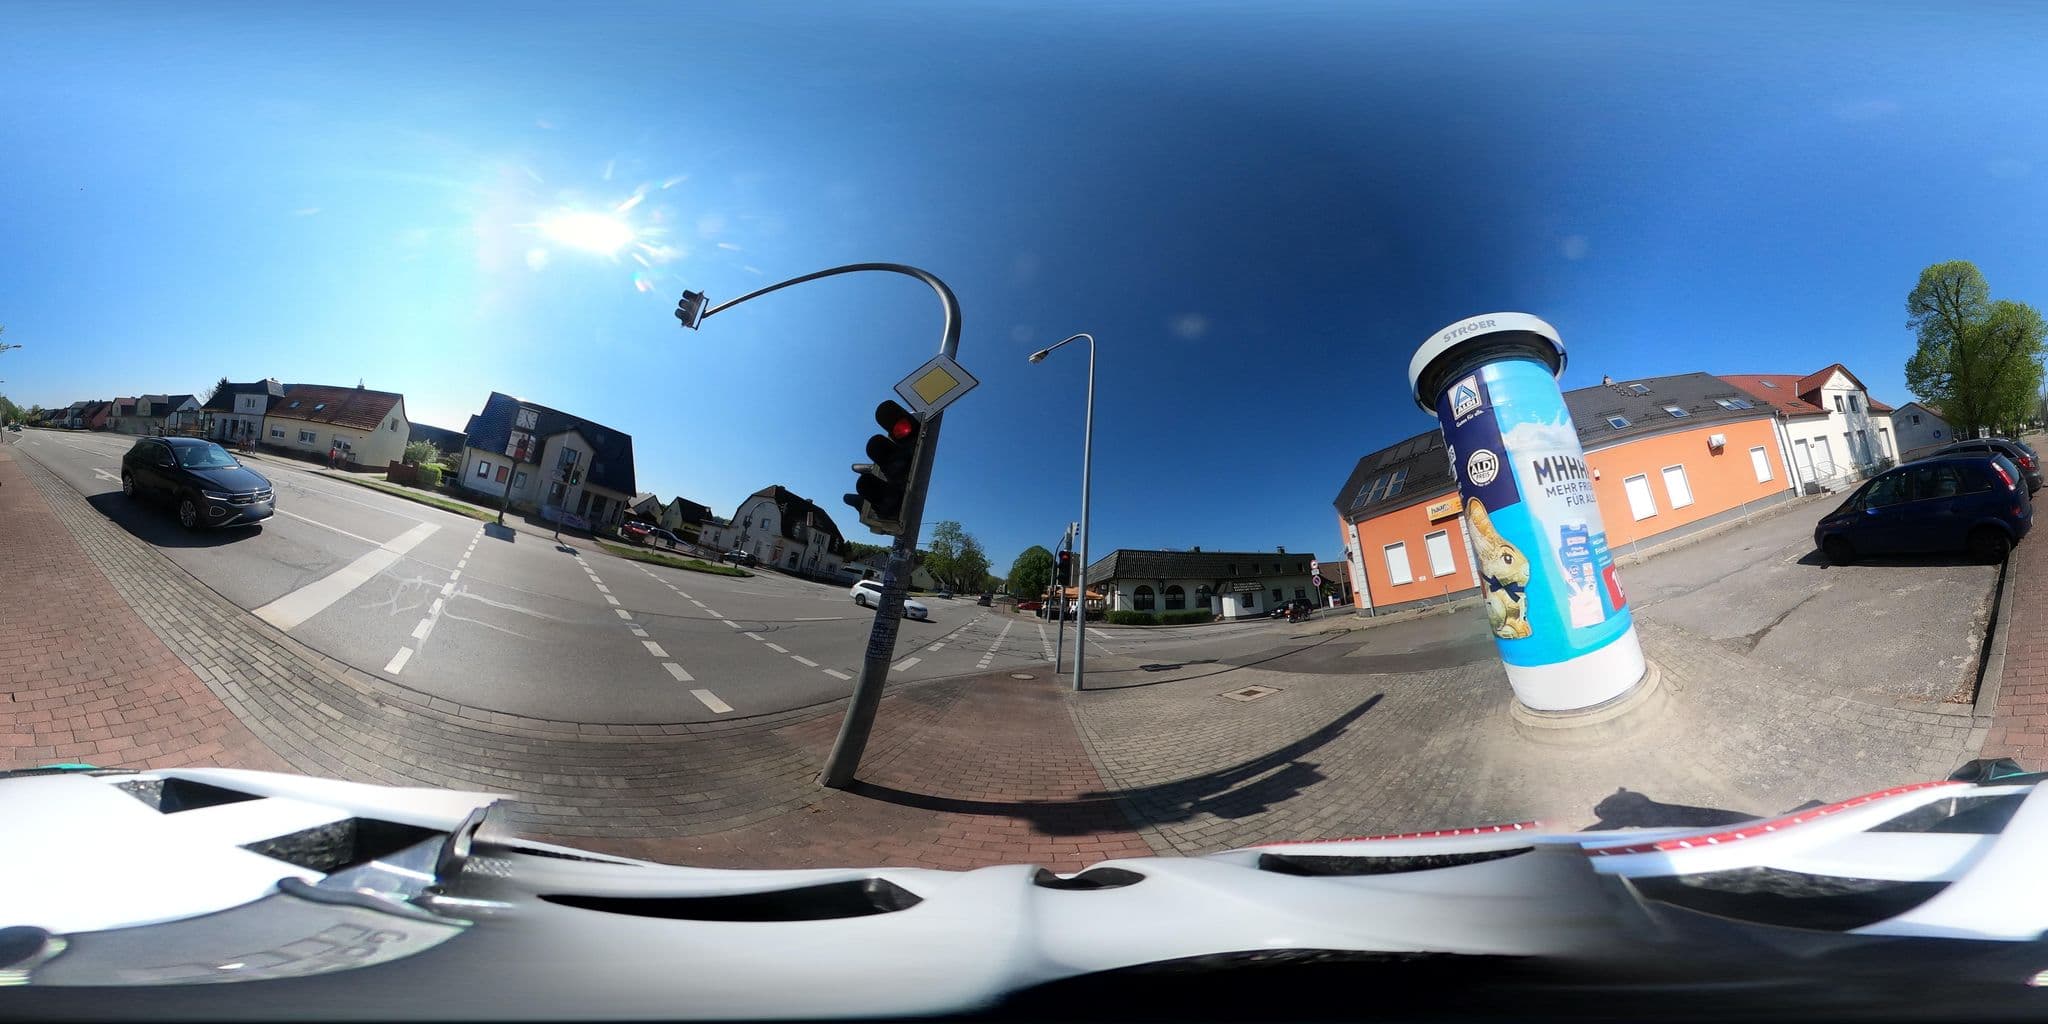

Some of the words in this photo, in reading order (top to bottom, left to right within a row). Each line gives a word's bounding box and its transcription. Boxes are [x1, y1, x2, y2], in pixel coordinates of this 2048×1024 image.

[1443, 320, 1496, 342] STRÖER
[1456, 398, 1478, 415] ALDI
[1471, 459, 1495, 475] ALDI
[1545, 482, 1578, 498] MEHR
[1566, 493, 1586, 507] FÜR
